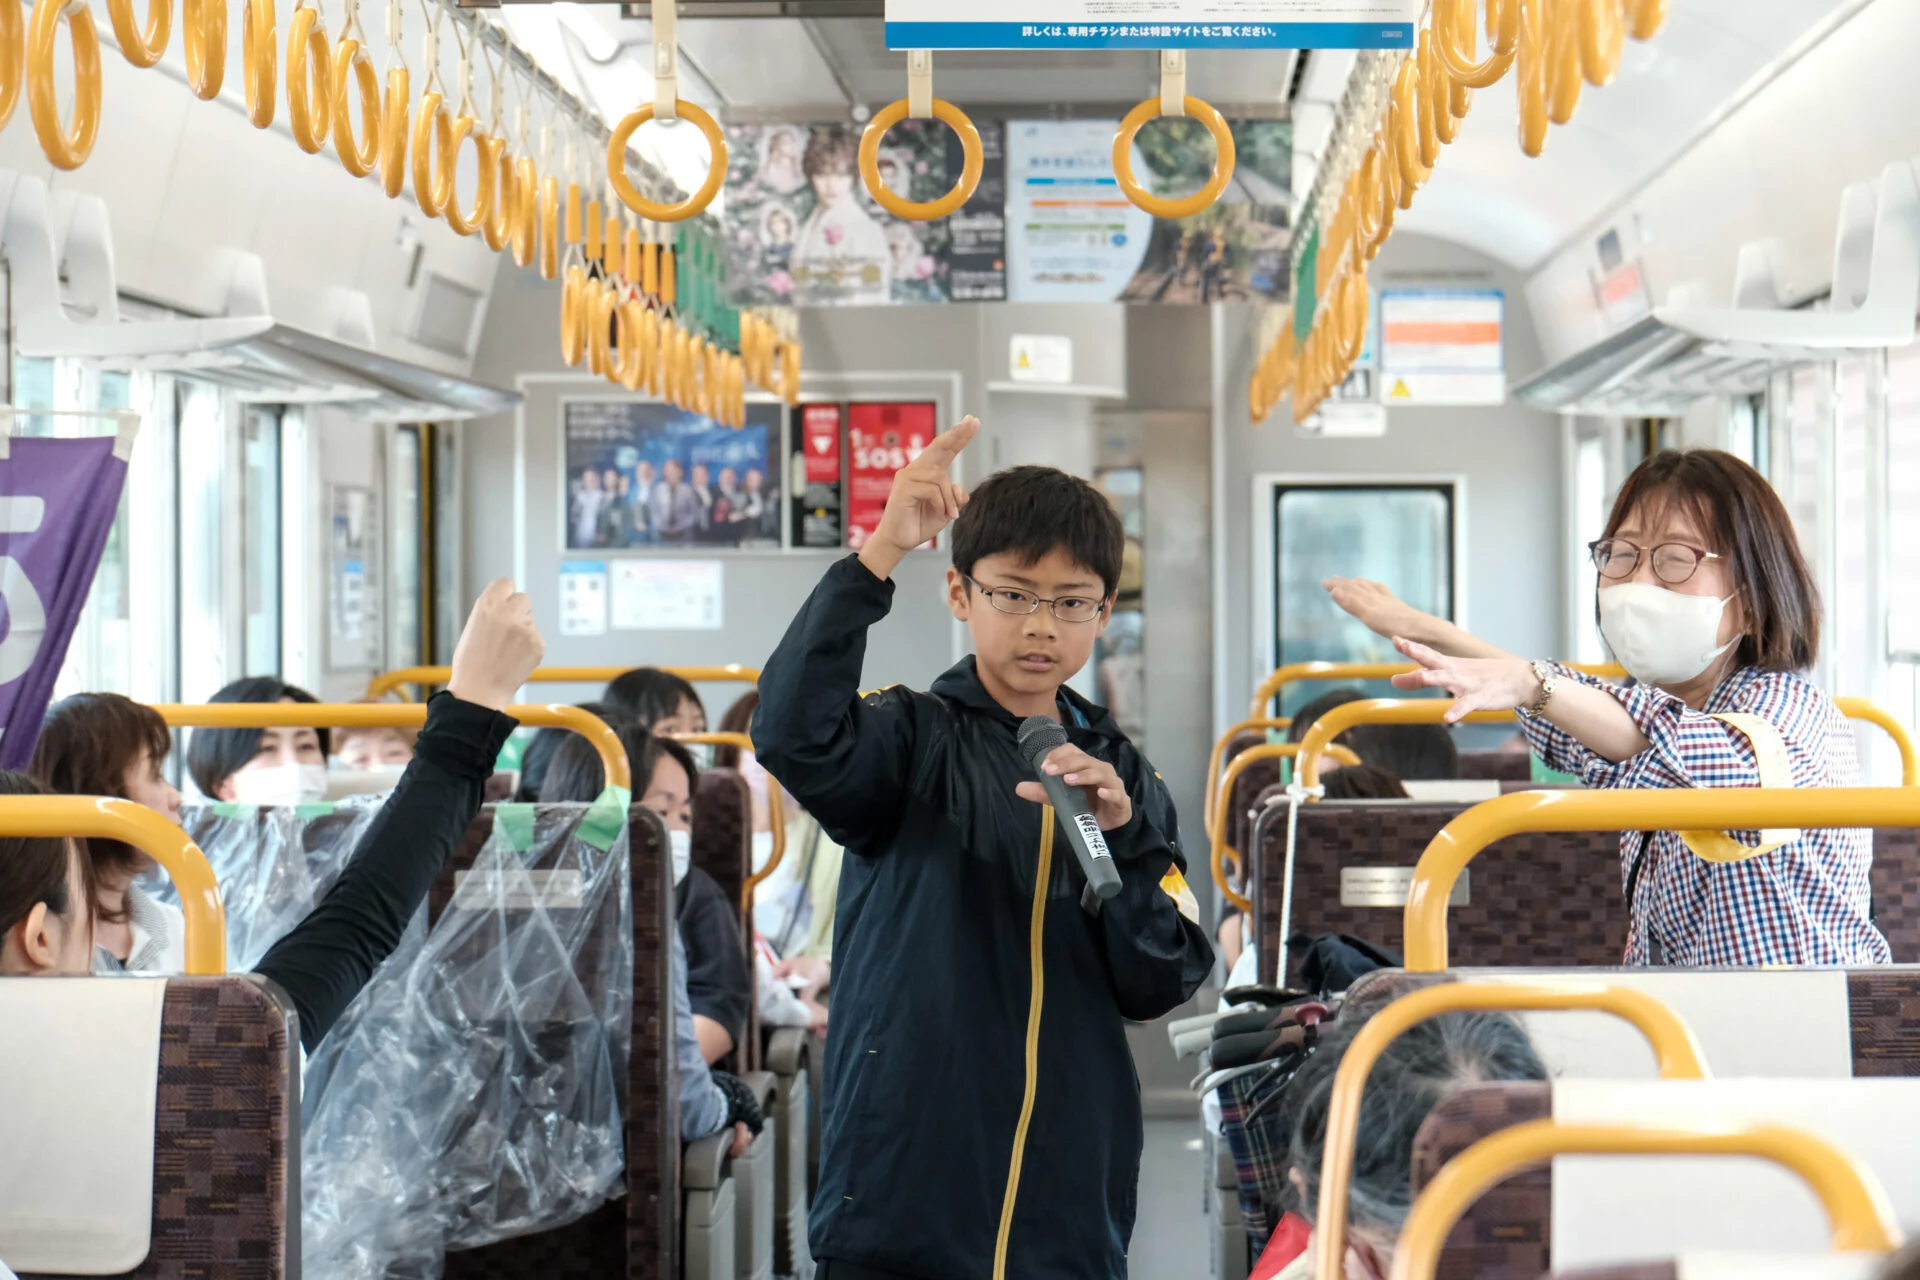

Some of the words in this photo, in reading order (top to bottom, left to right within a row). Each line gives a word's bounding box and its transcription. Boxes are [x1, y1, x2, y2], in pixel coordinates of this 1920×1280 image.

[1022, 25, 1277, 37] 詳しくは、専用チラシまたは特設サイトをご覧ください。
